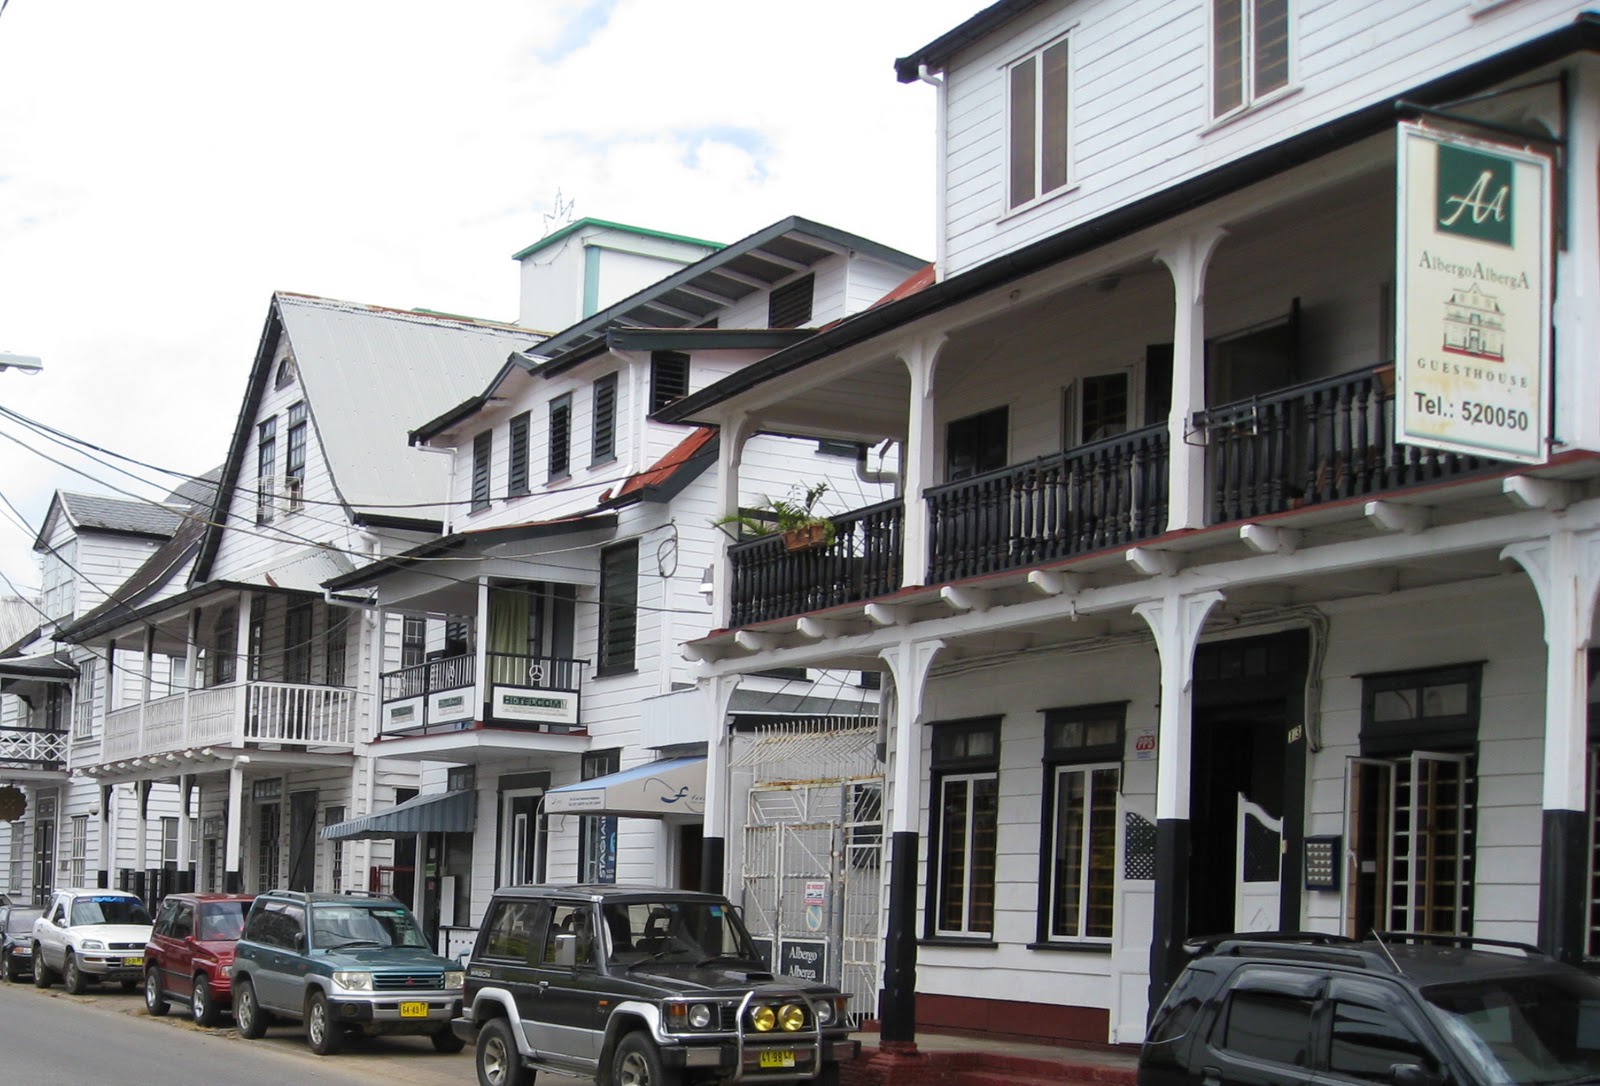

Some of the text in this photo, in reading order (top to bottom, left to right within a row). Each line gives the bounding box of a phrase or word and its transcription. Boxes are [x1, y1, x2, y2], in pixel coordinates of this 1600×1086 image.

[1416, 357, 1529, 389] GUESTHOUSE
[1414, 391, 1528, 431] Tel.: 520050
[788, 946, 818, 964] Albergo
[788, 965, 816, 981] Alberga
